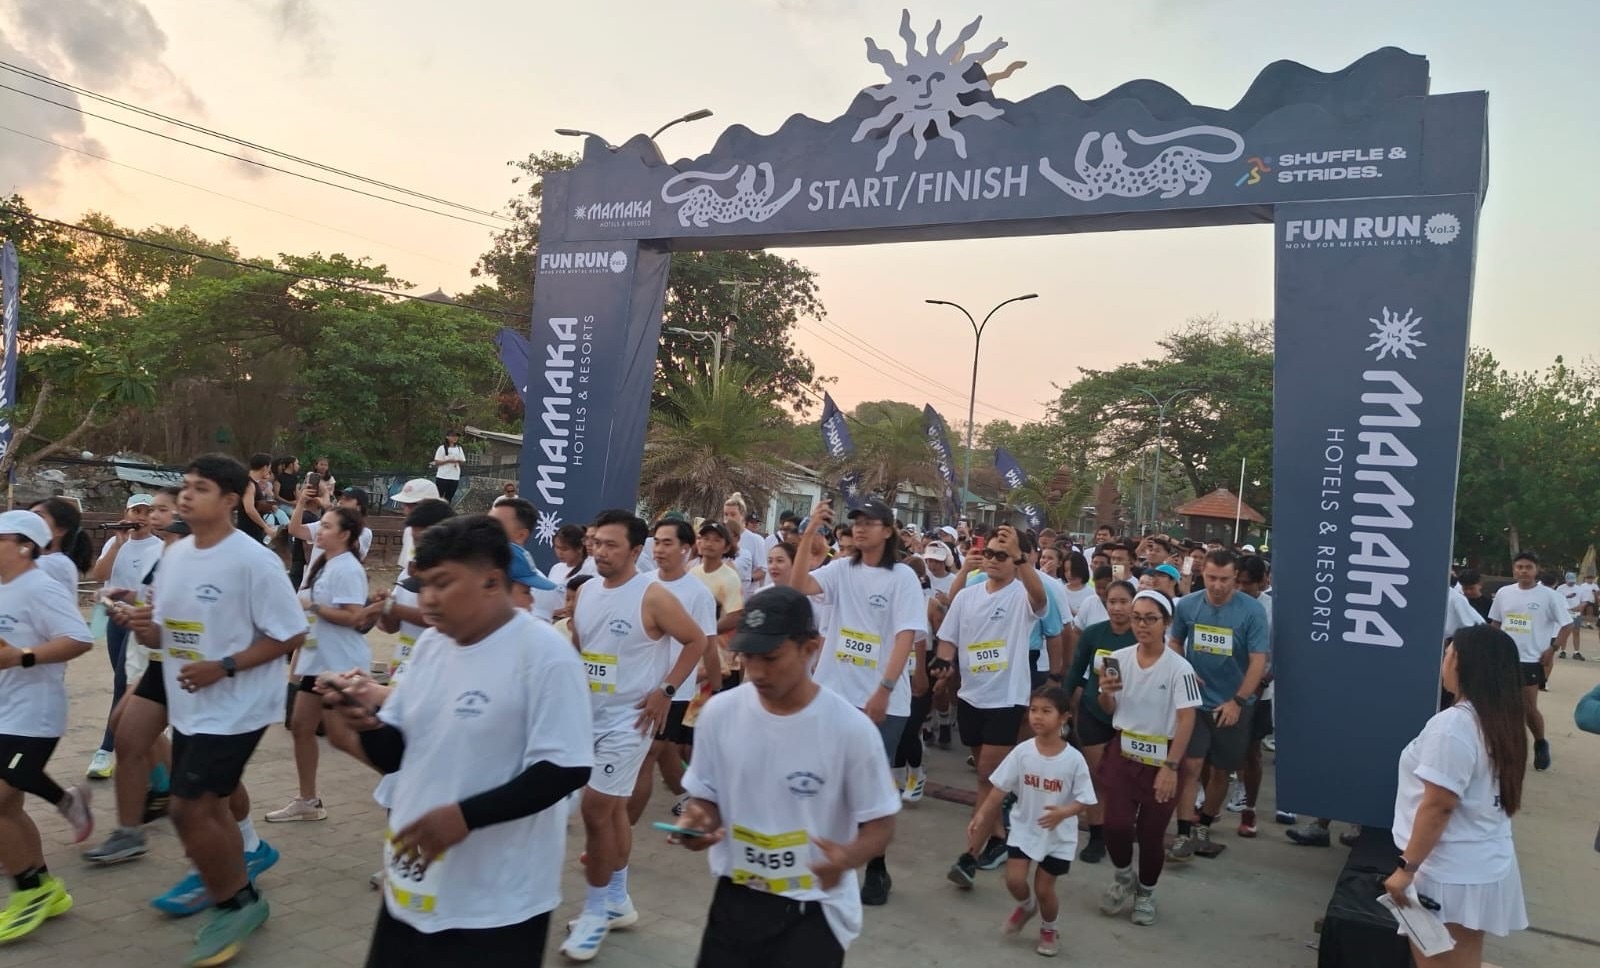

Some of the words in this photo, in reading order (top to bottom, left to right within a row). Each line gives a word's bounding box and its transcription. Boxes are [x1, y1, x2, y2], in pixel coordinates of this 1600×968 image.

[1279, 148, 1384, 167] SHUFFLE
[1388, 146, 1407, 160] &
[1277, 165, 1383, 183] STRIDES.
[807, 165, 1029, 211] START/FINISH
[587, 199, 652, 220] MAMAKA
[1285, 218, 1348, 242] FUN
[1354, 215, 1421, 239] RUN
[1429, 225, 1456, 235] Vol.3
[1339, 240, 1378, 248] MENTAL
[1383, 238, 1422, 246] HEALTH
[540, 252, 573, 270] FUN
[575, 252, 609, 268] RUN
[579, 314, 594, 383] RESORTS
[578, 390, 588, 400] &
[535, 317, 578, 505] MAMAKA
[572, 406, 587, 466] HOTELS
[1320, 428, 1345, 511] HOTELS
[1342, 370, 1423, 647] MAMAKA
[1319, 521, 1338, 535] &
[1311, 545, 1336, 643] RESORTS
[845, 638, 872, 653] 5209
[1201, 633, 1226, 645] 5398
[976, 649, 1000, 660] 5015
[584, 662, 606, 677] 215
[1131, 740, 1157, 754] 5231
[744, 847, 796, 870] 5459
